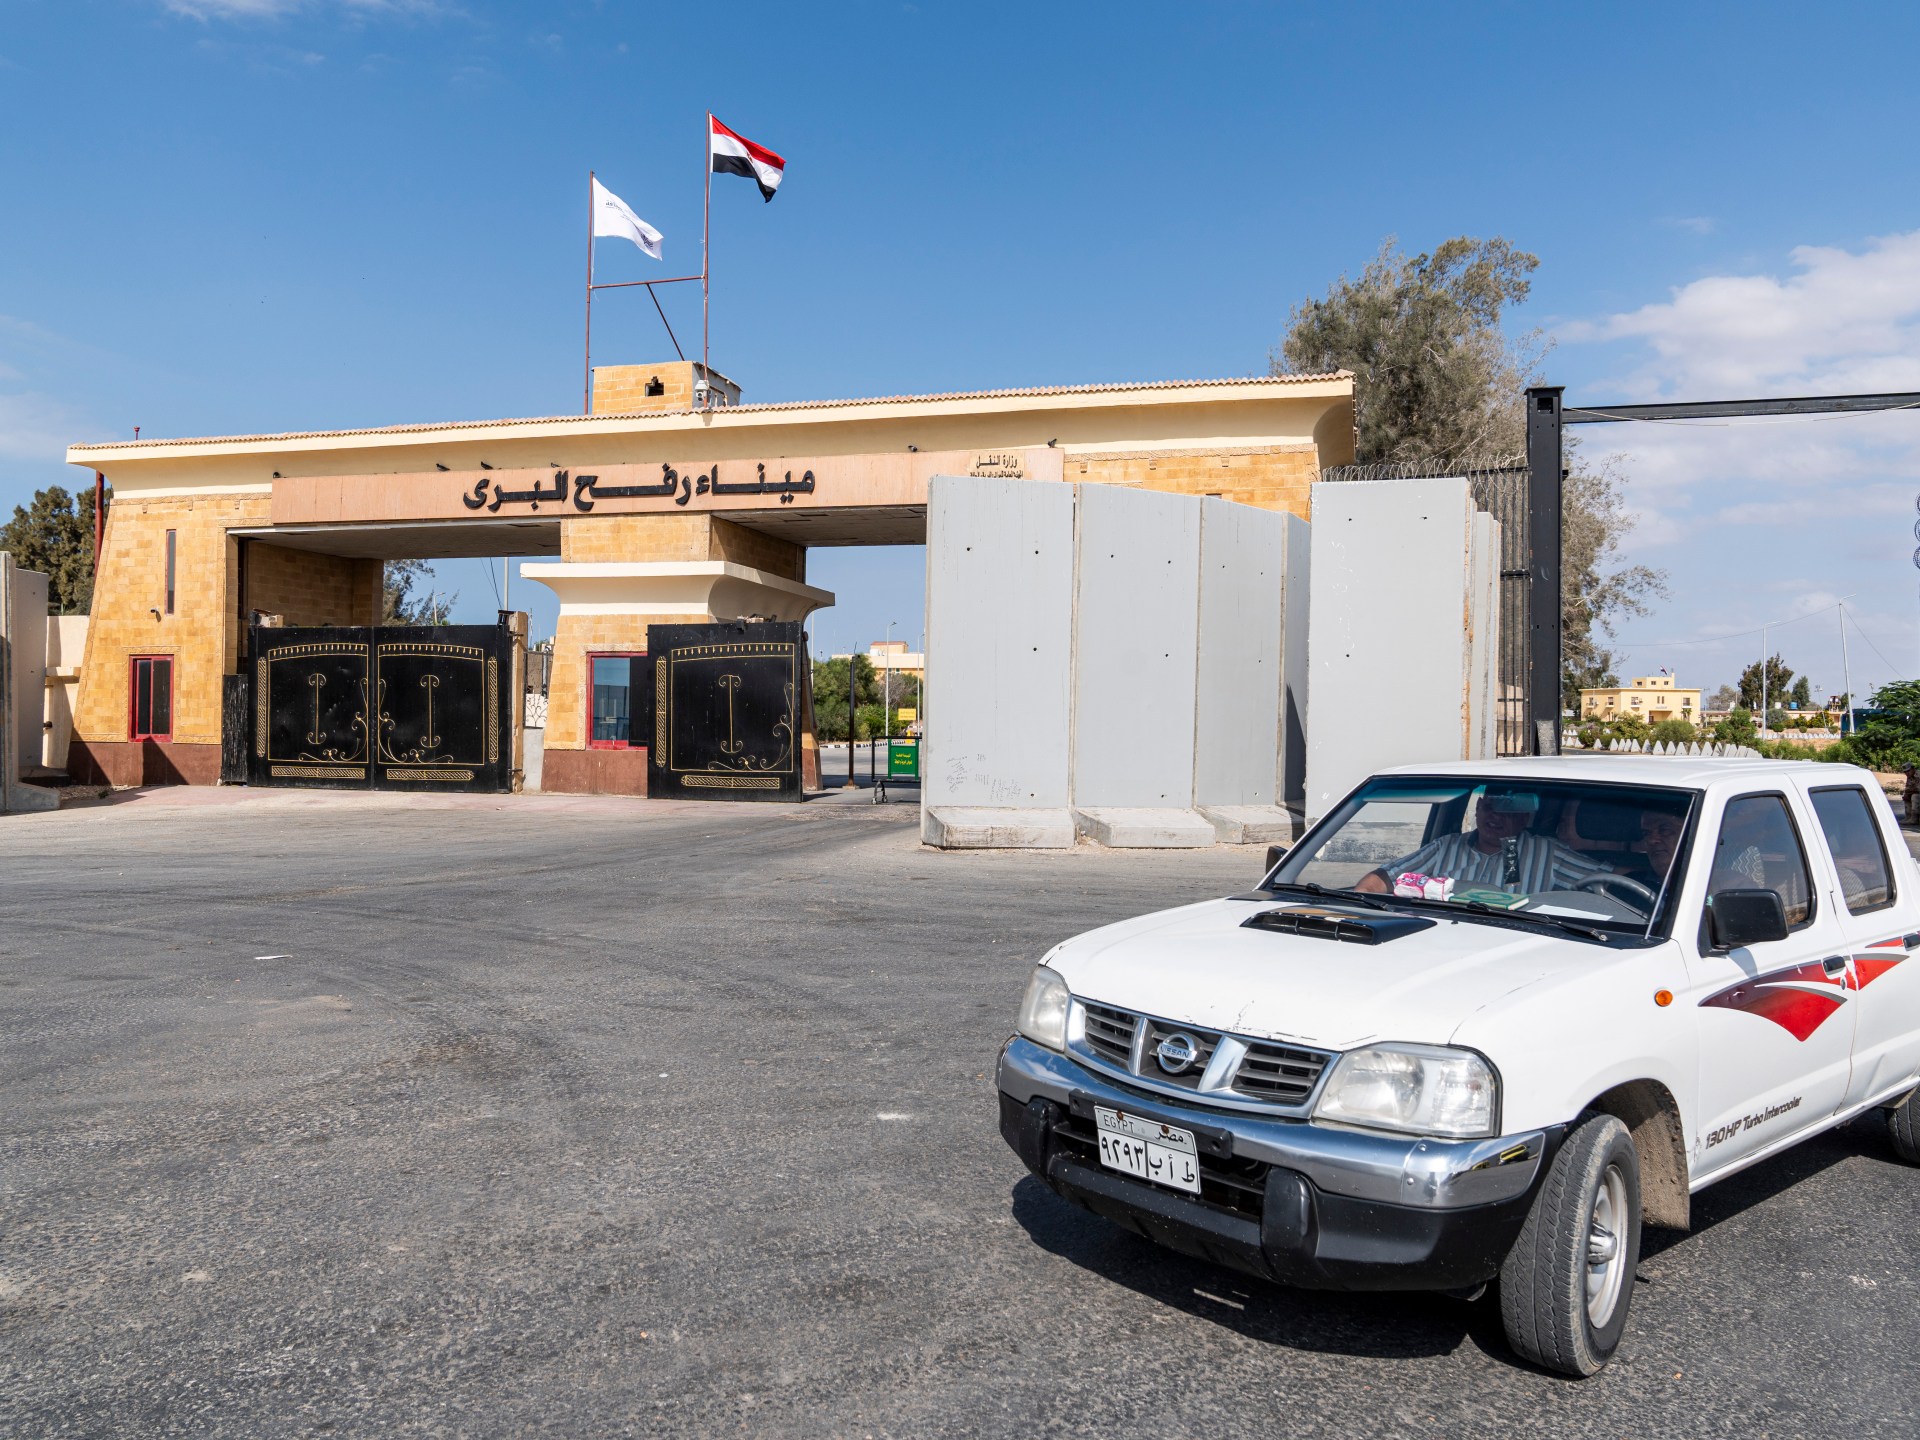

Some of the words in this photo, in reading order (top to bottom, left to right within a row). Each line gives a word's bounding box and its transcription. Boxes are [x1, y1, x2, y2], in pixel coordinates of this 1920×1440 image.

[976, 454, 1000, 468] النقل
[1003, 454, 1018, 468] وزارة
[574, 463, 692, 511] رفح
[696, 463, 815, 504] ميناء
[1160, 1045, 1190, 1058] NISSAN
[1743, 1114, 1764, 1131] Turbo
[1764, 1096, 1802, 1121] Intercooler
[1103, 1114, 1135, 1133] EGYPT
[1154, 1131, 1184, 1143] مصر
